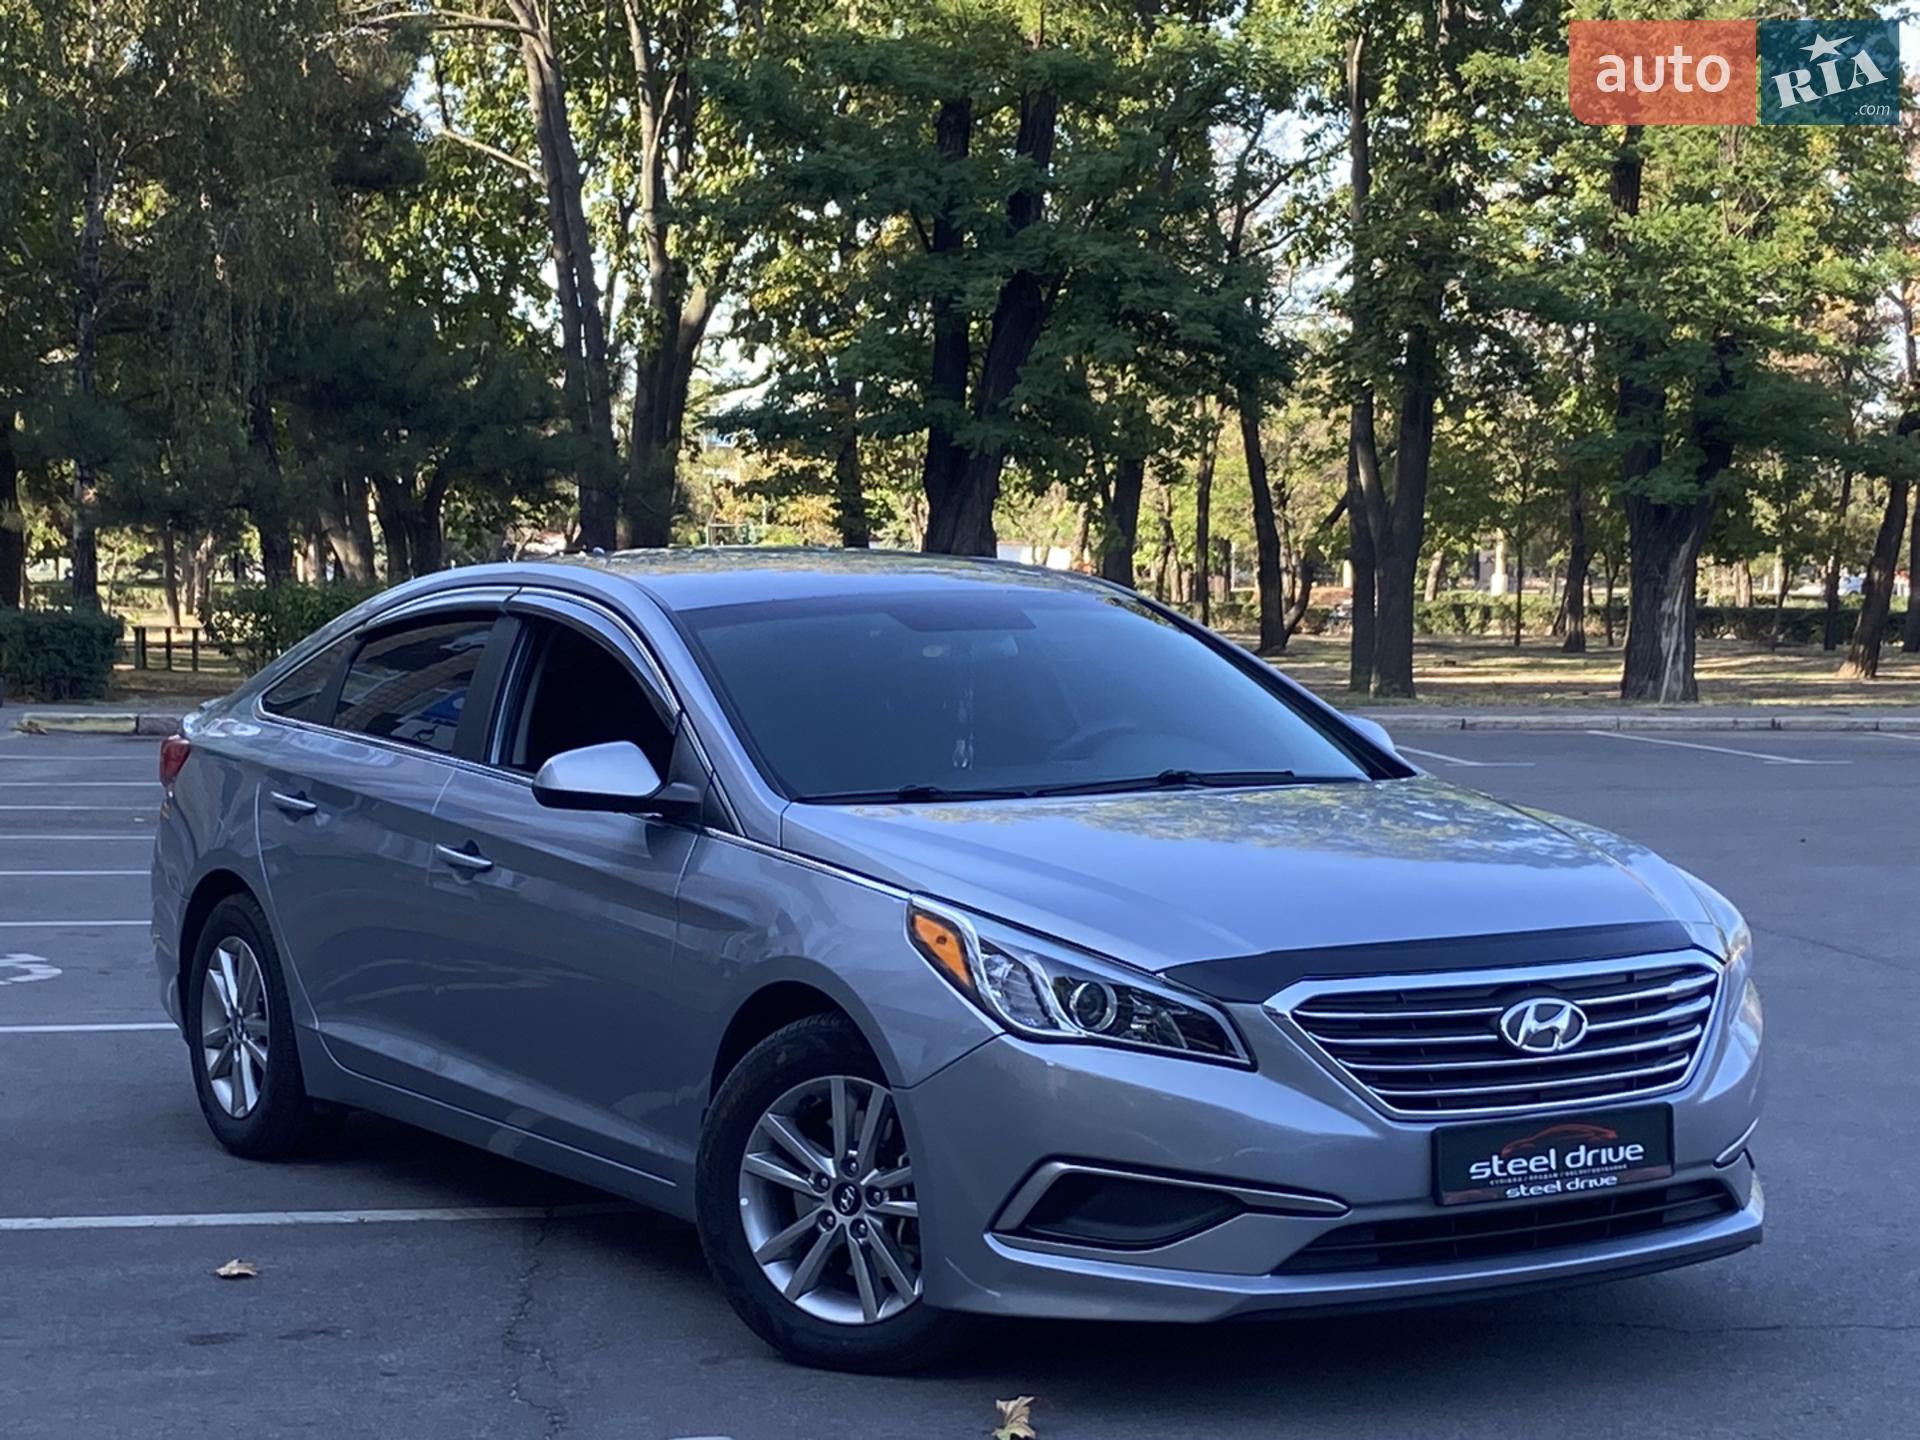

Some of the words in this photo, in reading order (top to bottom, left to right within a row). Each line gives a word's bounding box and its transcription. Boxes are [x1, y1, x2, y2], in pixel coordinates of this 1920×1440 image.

[1469, 1148, 1556, 1180] steel
[1565, 1143, 1645, 1169] drive
[1506, 1180, 1562, 1198] steel
[1566, 1175, 1618, 1192] drive
